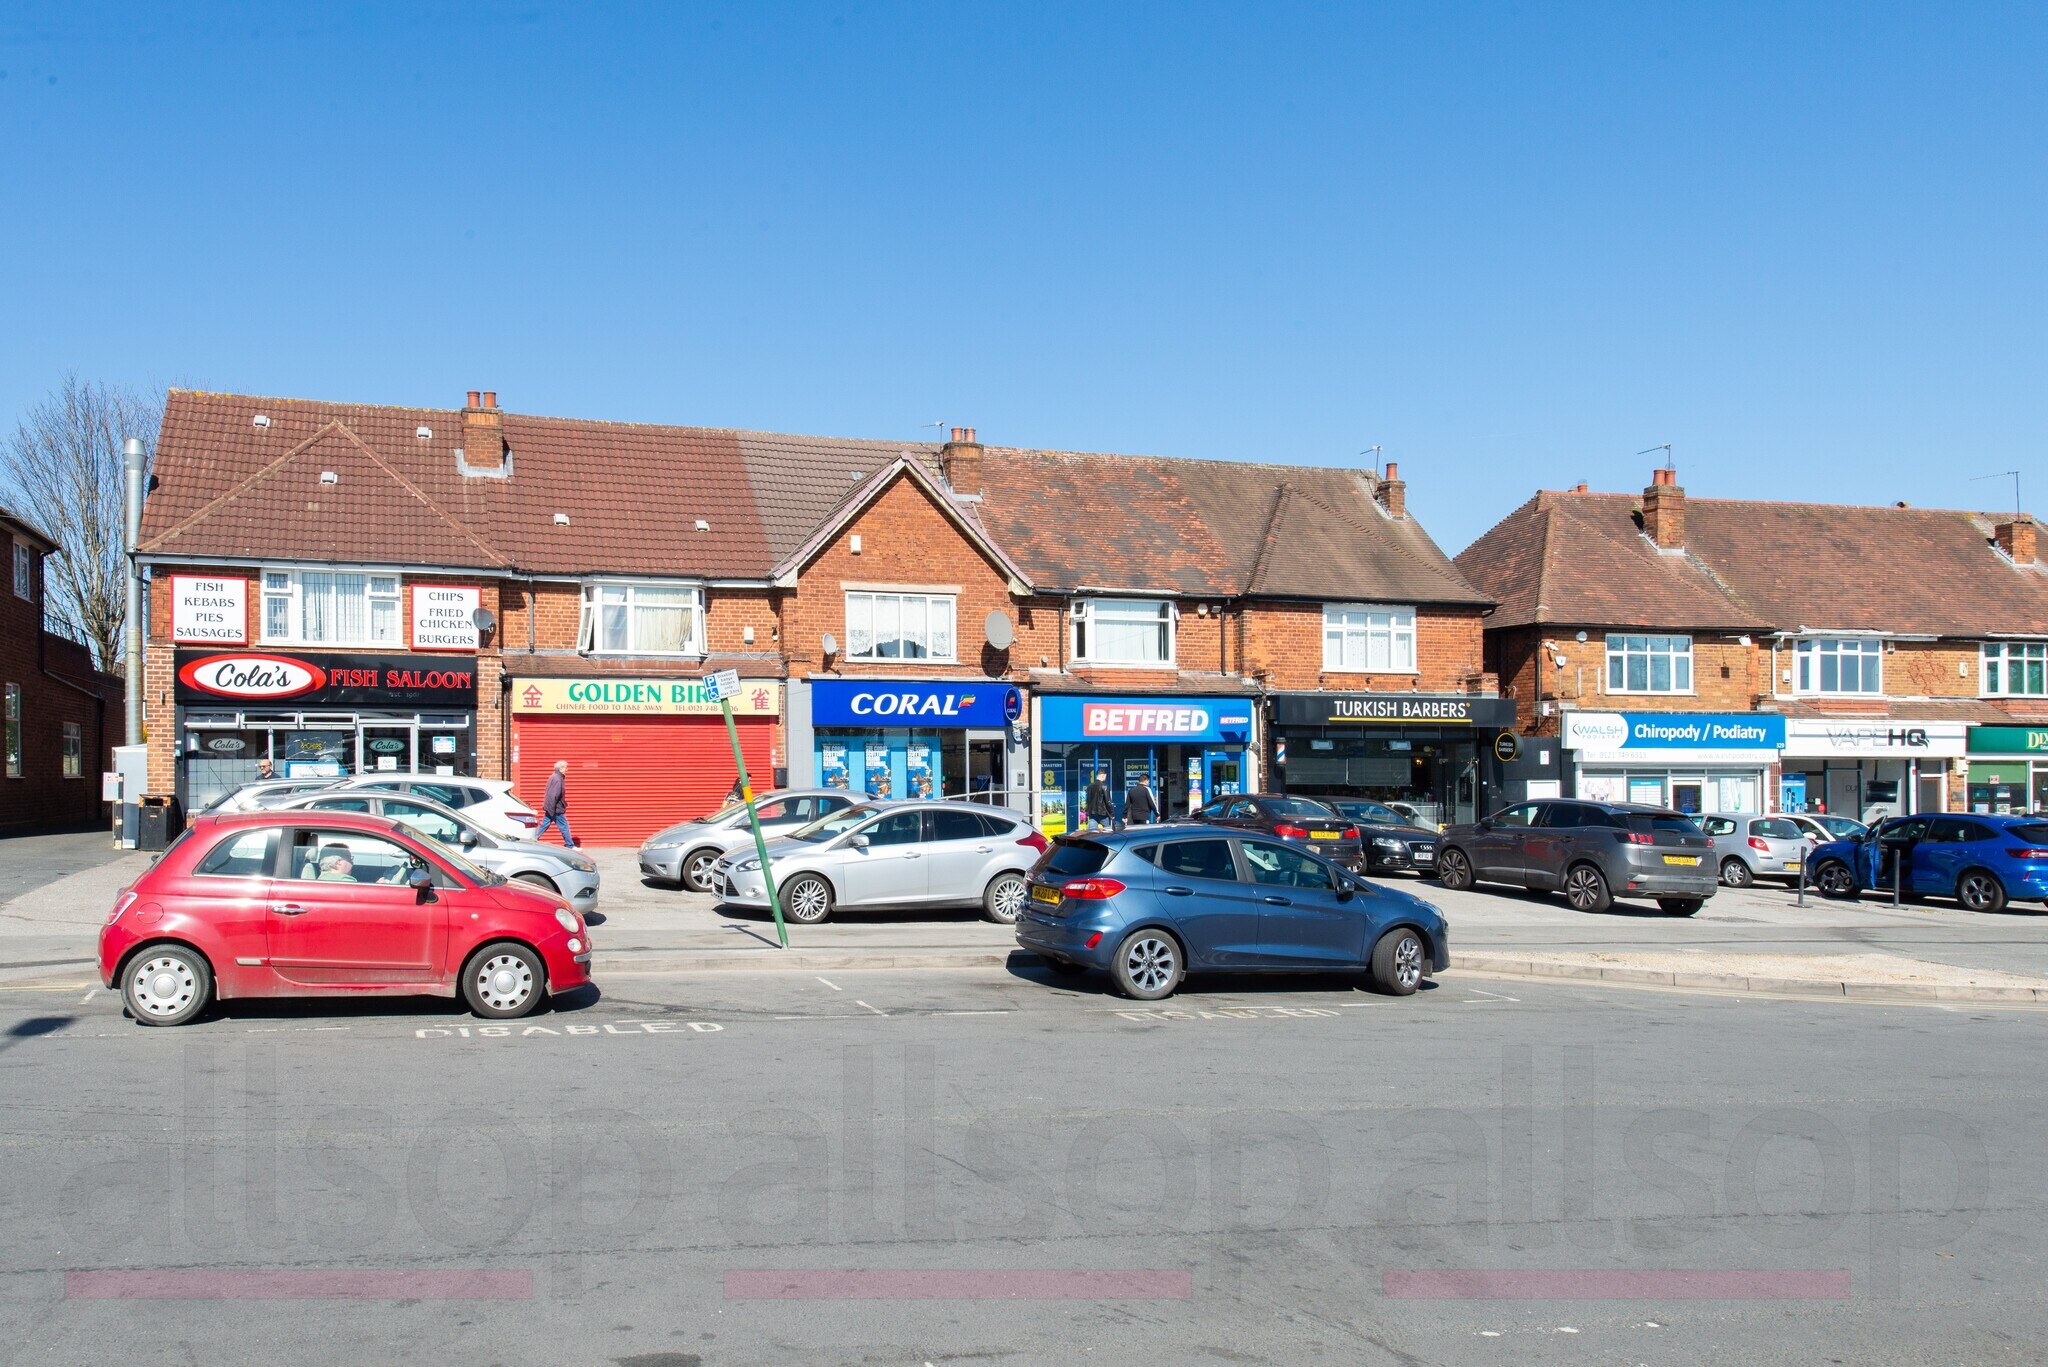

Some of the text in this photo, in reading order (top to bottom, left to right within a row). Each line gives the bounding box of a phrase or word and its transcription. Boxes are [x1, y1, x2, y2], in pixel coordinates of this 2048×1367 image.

[195, 582, 224, 592] FISH
[428, 591, 464, 602] CHIPS
[184, 597, 235, 608] KEBABS
[195, 612, 224, 623] PIES
[429, 608, 464, 617] FRIED
[419, 619, 473, 629] CHICKEN
[176, 627, 243, 638] SAUSAGES
[418, 634, 474, 644] BURGERS
[215, 663, 291, 688] Cola's
[330, 668, 471, 689] FISH SALOON
[522, 684, 543, 708] 金
[568, 683, 721, 703] GOLDEN BIR
[750, 688, 770, 710] 雀
[850, 693, 959, 716] CORAL
[555, 703, 586, 711] CHINESE
[588, 703, 609, 711] FOOD
[643, 704, 663, 712] AWAY
[1334, 700, 1466, 718] TURKISH BARBERS
[1088, 708, 1210, 731] BETFRED
[1577, 725, 1623, 735] WALSH
[1634, 723, 1701, 741] Chiropody
[1713, 724, 1767, 742] Podiatry
[213, 739, 240, 749] Cola's
[375, 740, 399, 750] Cola's
[1044, 770, 1055, 786] 8
[414, 1021, 725, 1039] DISABLED
